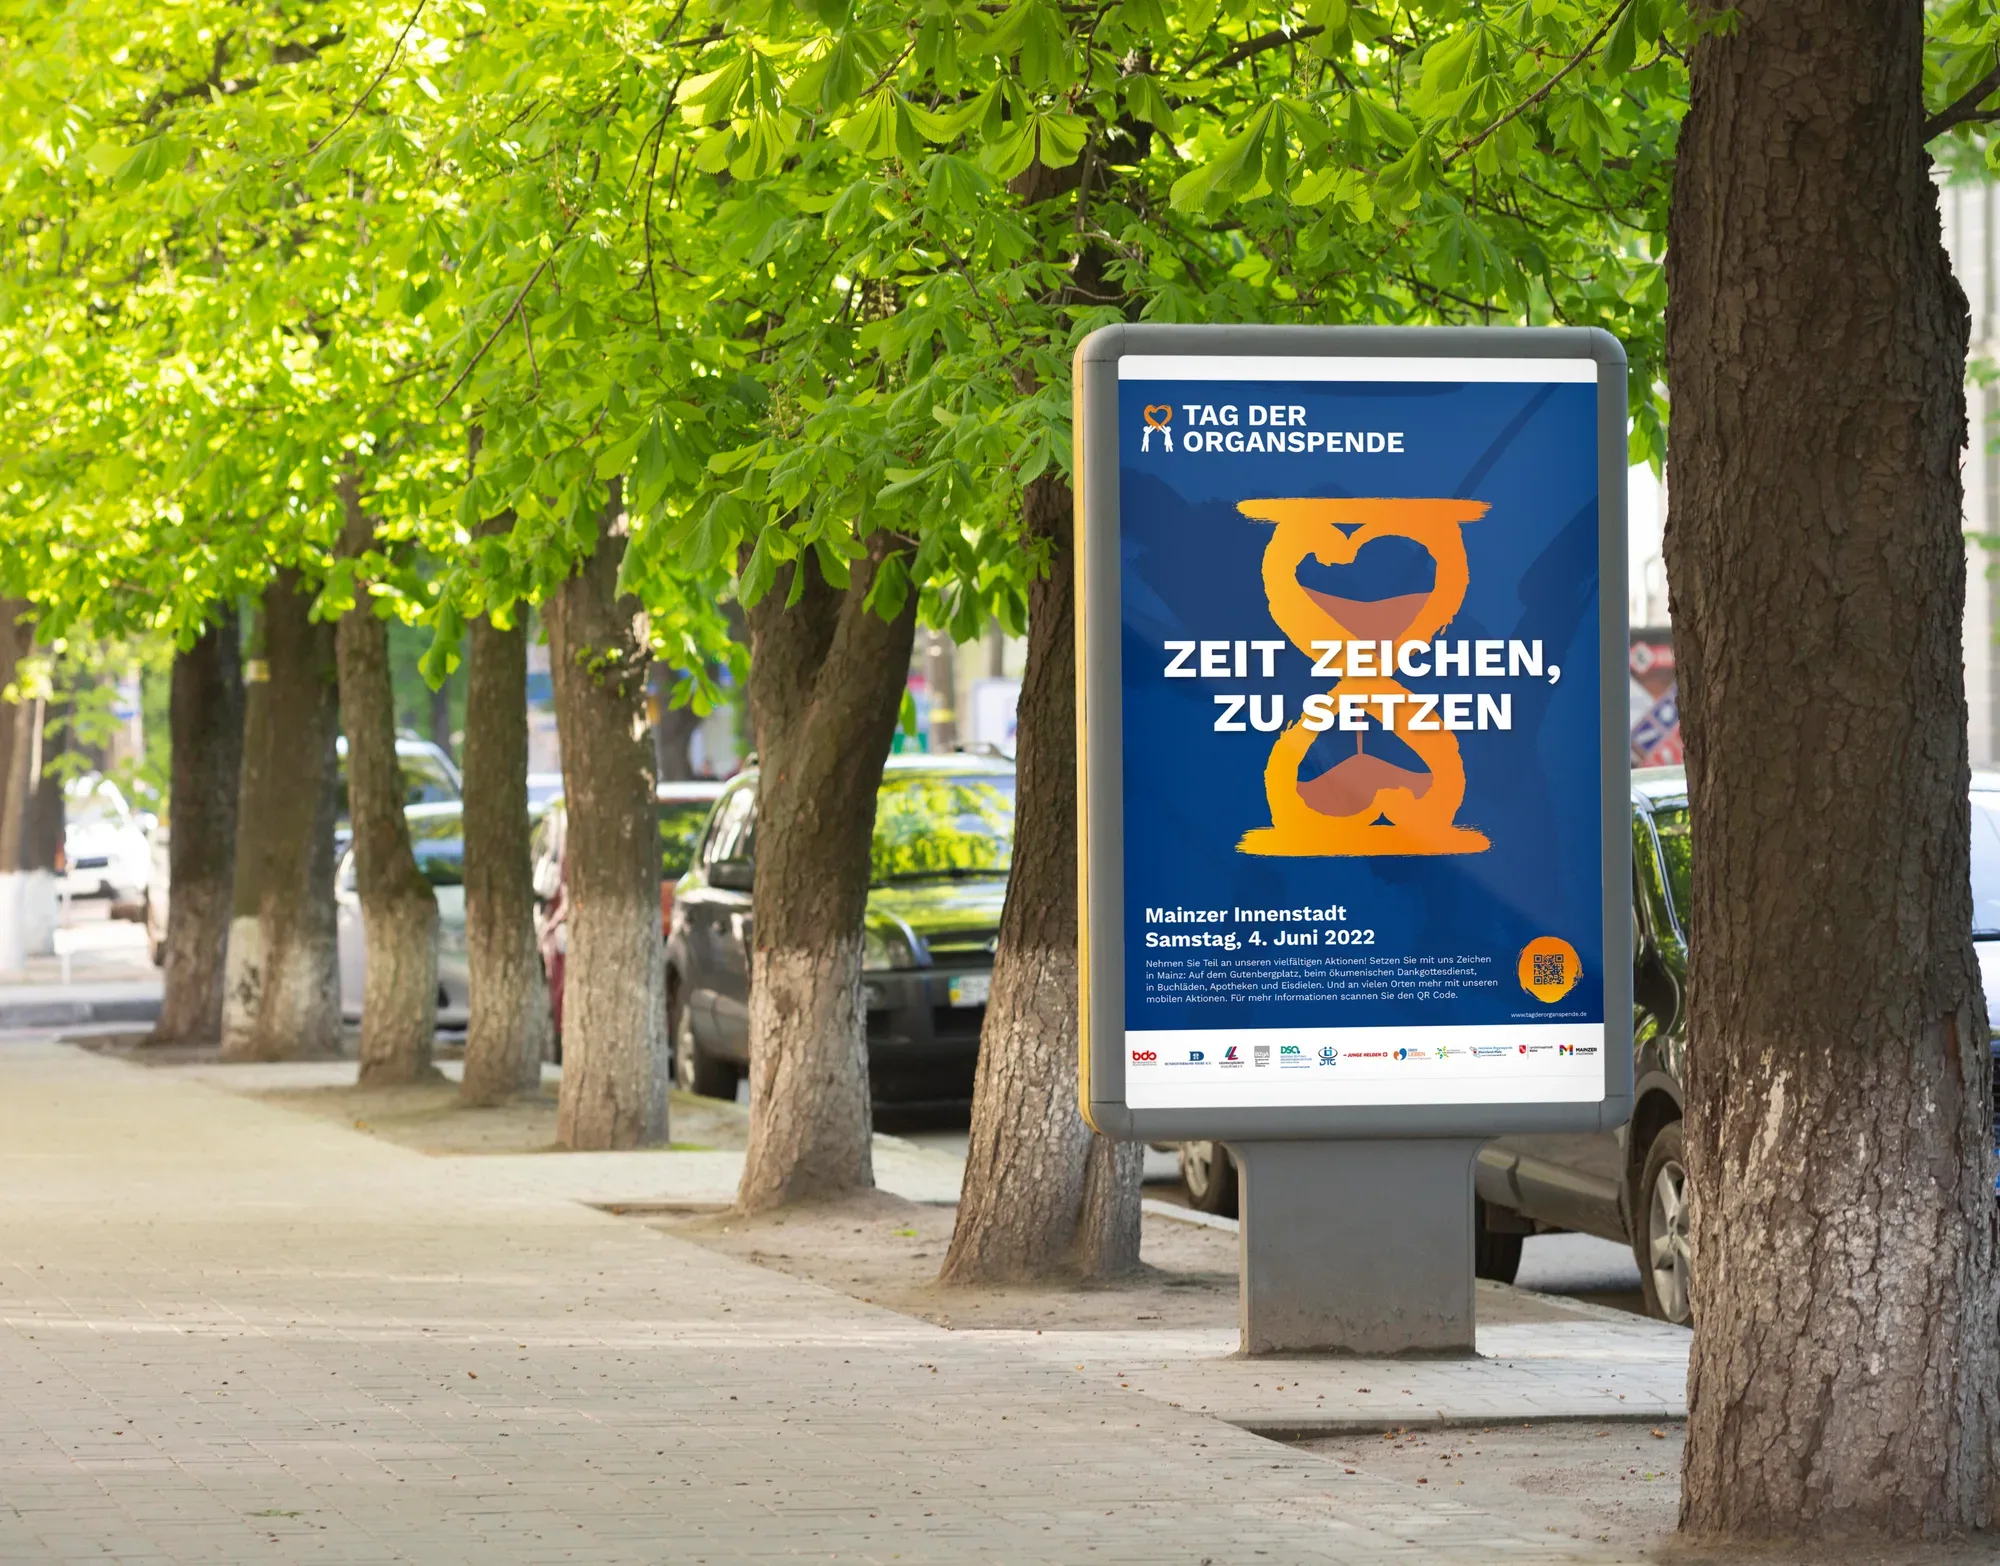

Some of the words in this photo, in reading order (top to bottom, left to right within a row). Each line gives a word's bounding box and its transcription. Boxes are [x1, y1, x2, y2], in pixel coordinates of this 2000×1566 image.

[1183, 404, 1239, 426] TAG
[1249, 405, 1306, 426] DER
[1183, 431, 1404, 453] ORGANSPENDE
[1164, 640, 1285, 678] ZEIT
[1310, 640, 1561, 684] ZEICHEN,
[1214, 694, 1284, 732] ZU
[1302, 693, 1512, 732] SETZEN
[1146, 907, 1228, 923] Mainzer
[1235, 905, 1346, 922] Innenstadt
[1146, 931, 1241, 950] Samstag,
[1248, 931, 1267, 946] 4.
[1274, 929, 1318, 945] Juni
[1325, 929, 1375, 945] 2022
[1274, 958, 1322, 967] vielfältigen
[1230, 970, 1301, 979] Gutenbergplatz,
[1329, 968, 1394, 976] ökumenischen
[1398, 968, 1476, 977] Dankgottesdienst,
[1157, 983, 1207, 992] Buchläden,
[1210, 982, 1258, 992] Apotheken
[1275, 992, 1337, 1001] Informationen
[1417, 992, 1430, 1000] QR
[1132, 1050, 1157, 1061] bdo
